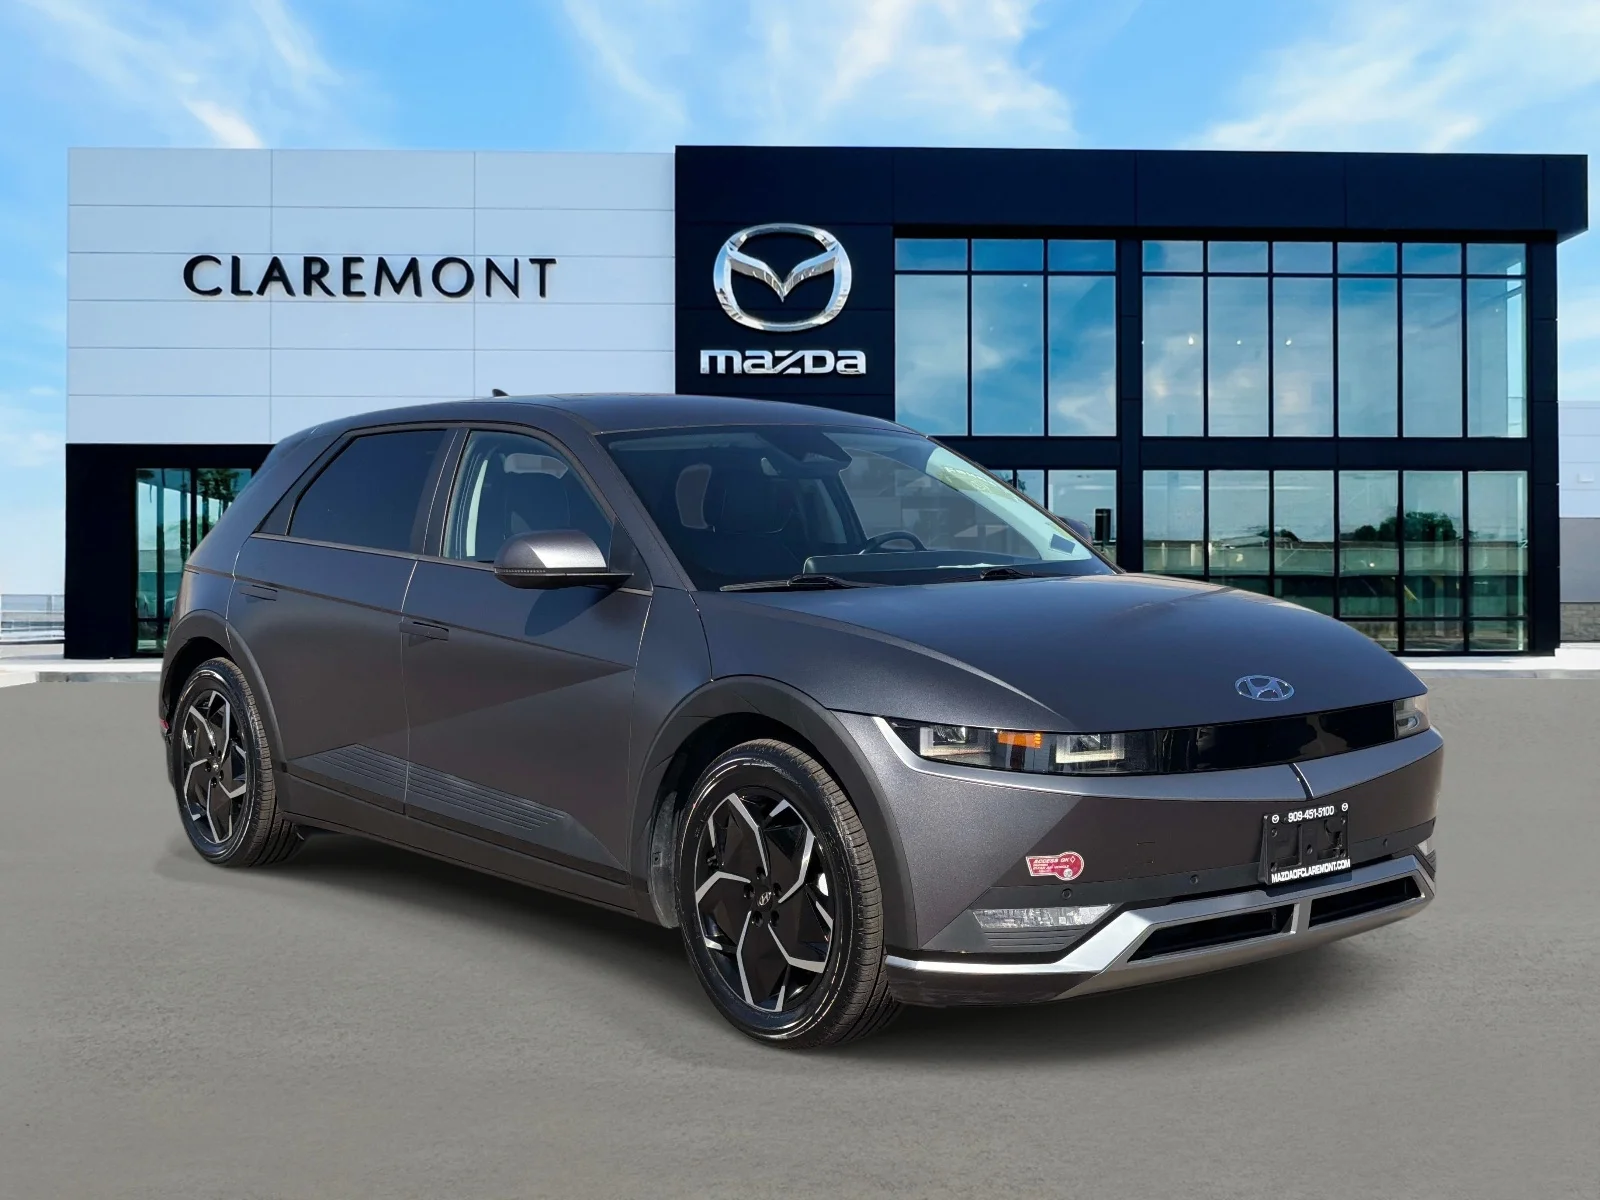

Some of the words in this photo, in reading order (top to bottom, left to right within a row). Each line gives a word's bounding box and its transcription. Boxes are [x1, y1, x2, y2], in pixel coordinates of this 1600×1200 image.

[184, 255, 557, 298] CLAREMONT
[1288, 806, 1334, 822] 909-451-5100
[1271, 859, 1351, 884] MAZDAOFCLAREMONT.COM
